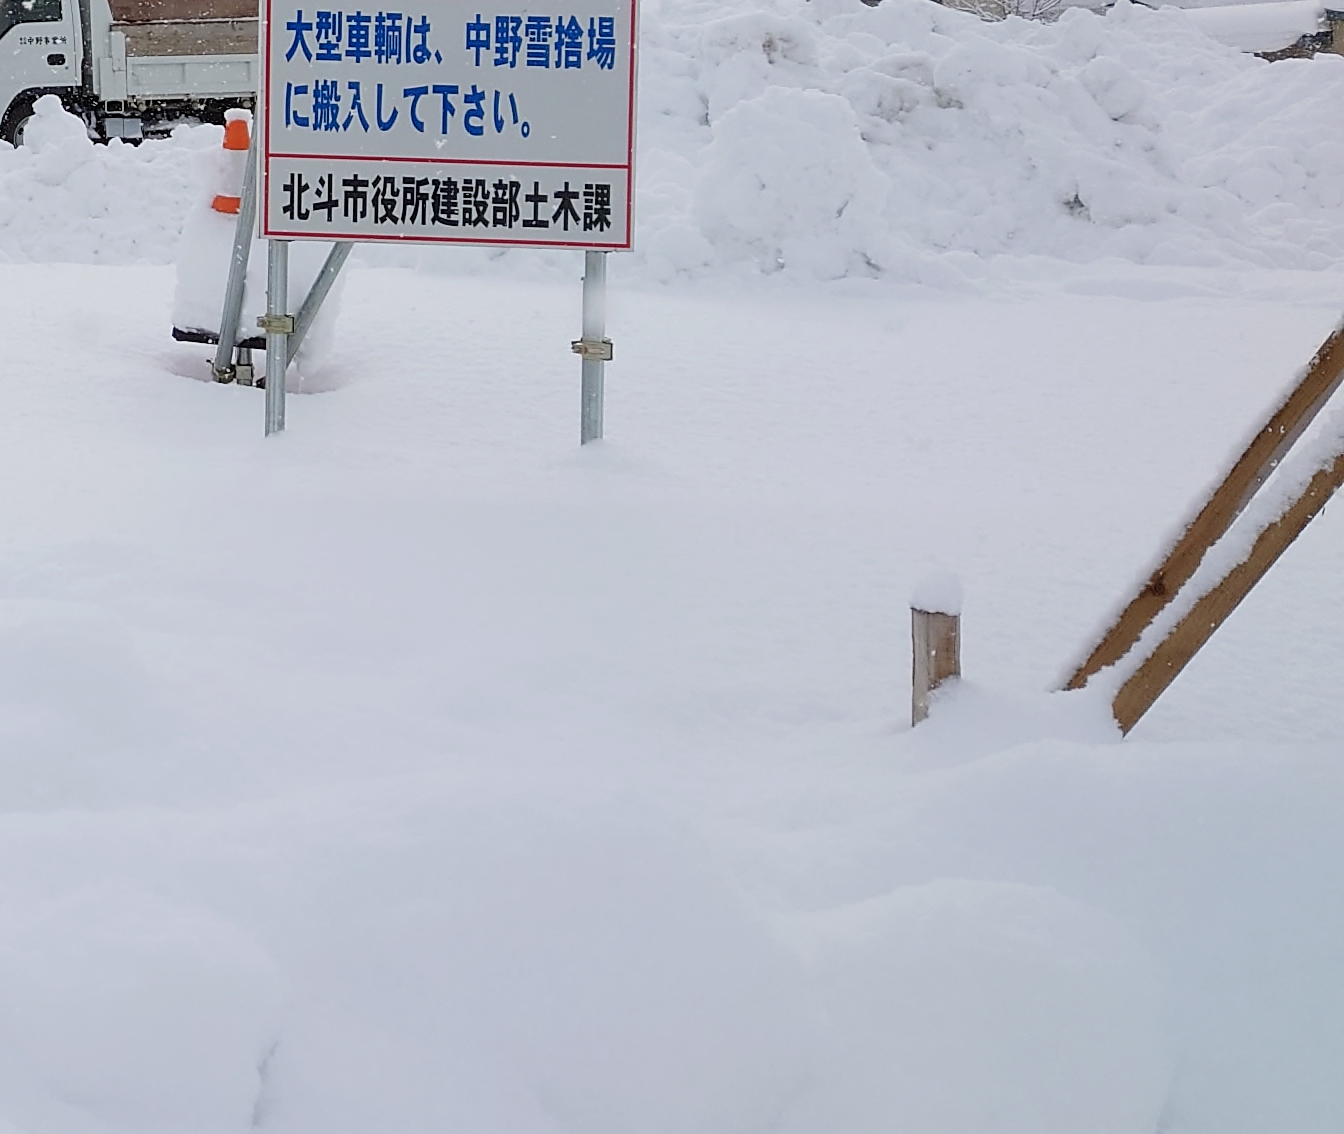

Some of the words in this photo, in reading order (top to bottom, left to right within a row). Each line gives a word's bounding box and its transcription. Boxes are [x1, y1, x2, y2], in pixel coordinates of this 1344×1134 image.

[284, 79, 531, 138] に搬入して下さい。
[282, 173, 612, 232] 北斗市役所建設部土木課
